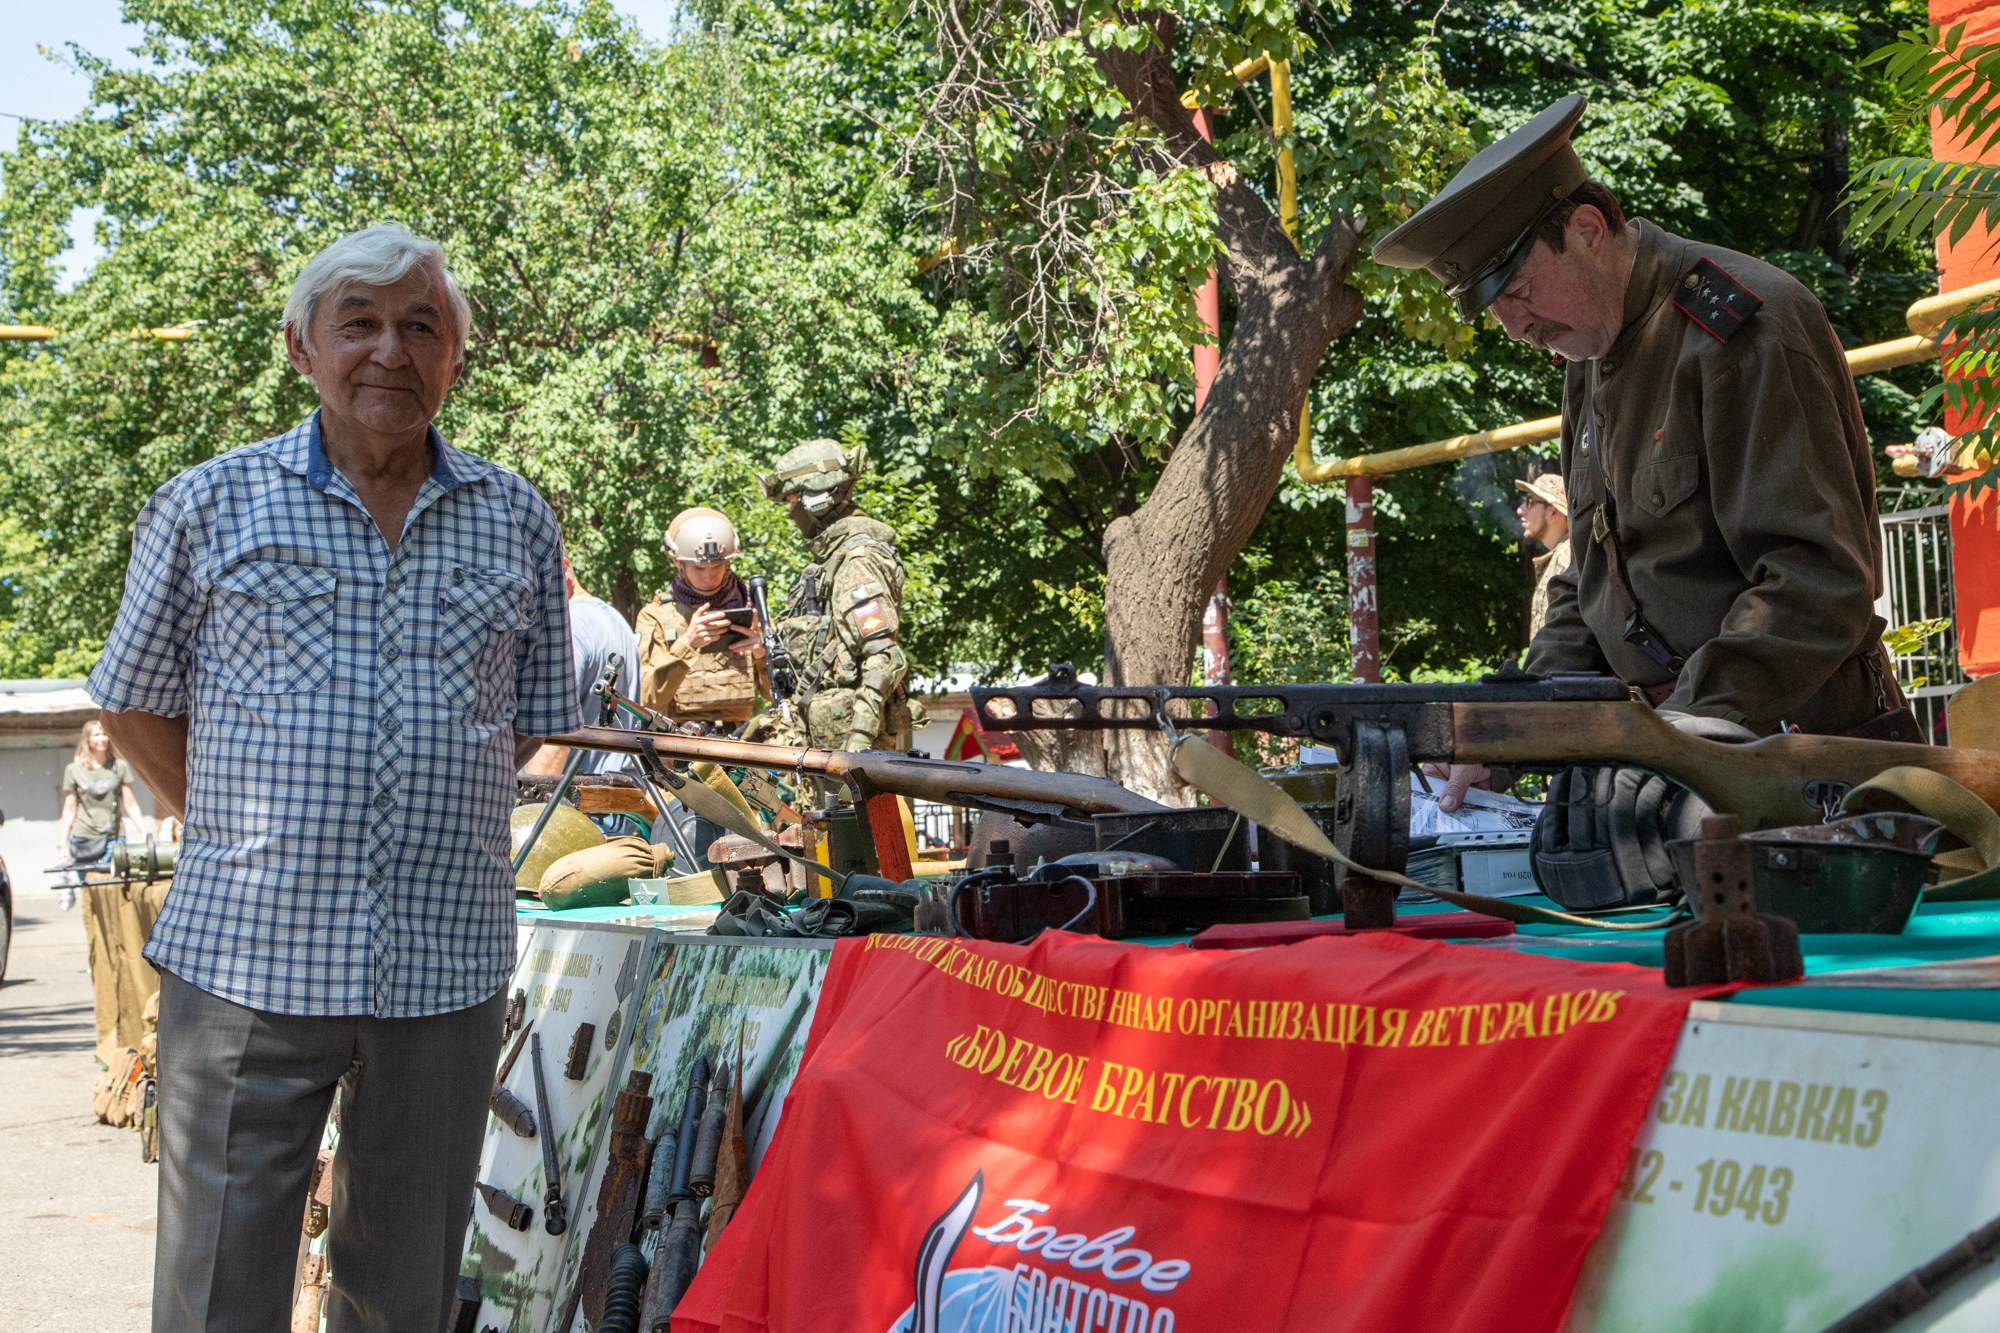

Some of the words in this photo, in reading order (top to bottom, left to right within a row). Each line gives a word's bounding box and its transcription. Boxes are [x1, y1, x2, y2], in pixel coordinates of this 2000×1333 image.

[1517, 871, 1532, 880] 020
[552, 986, 572, 1013] 1943
[1178, 998, 1409, 1051] ОРГАНИЗАЦИЯ
[1408, 989, 1626, 1047] ВЕТЕРАНОВ
[945, 1024, 1089, 1104] «БОЕВОЕ
[1089, 1061, 1312, 1139] БРАТСТВО»
[1658, 1071, 1711, 1128] ЗА
[1715, 1076, 1889, 1148] КАВКАЗ
[1693, 1158, 1794, 1226] 1943
[972, 1199, 1190, 1292] Боевое
